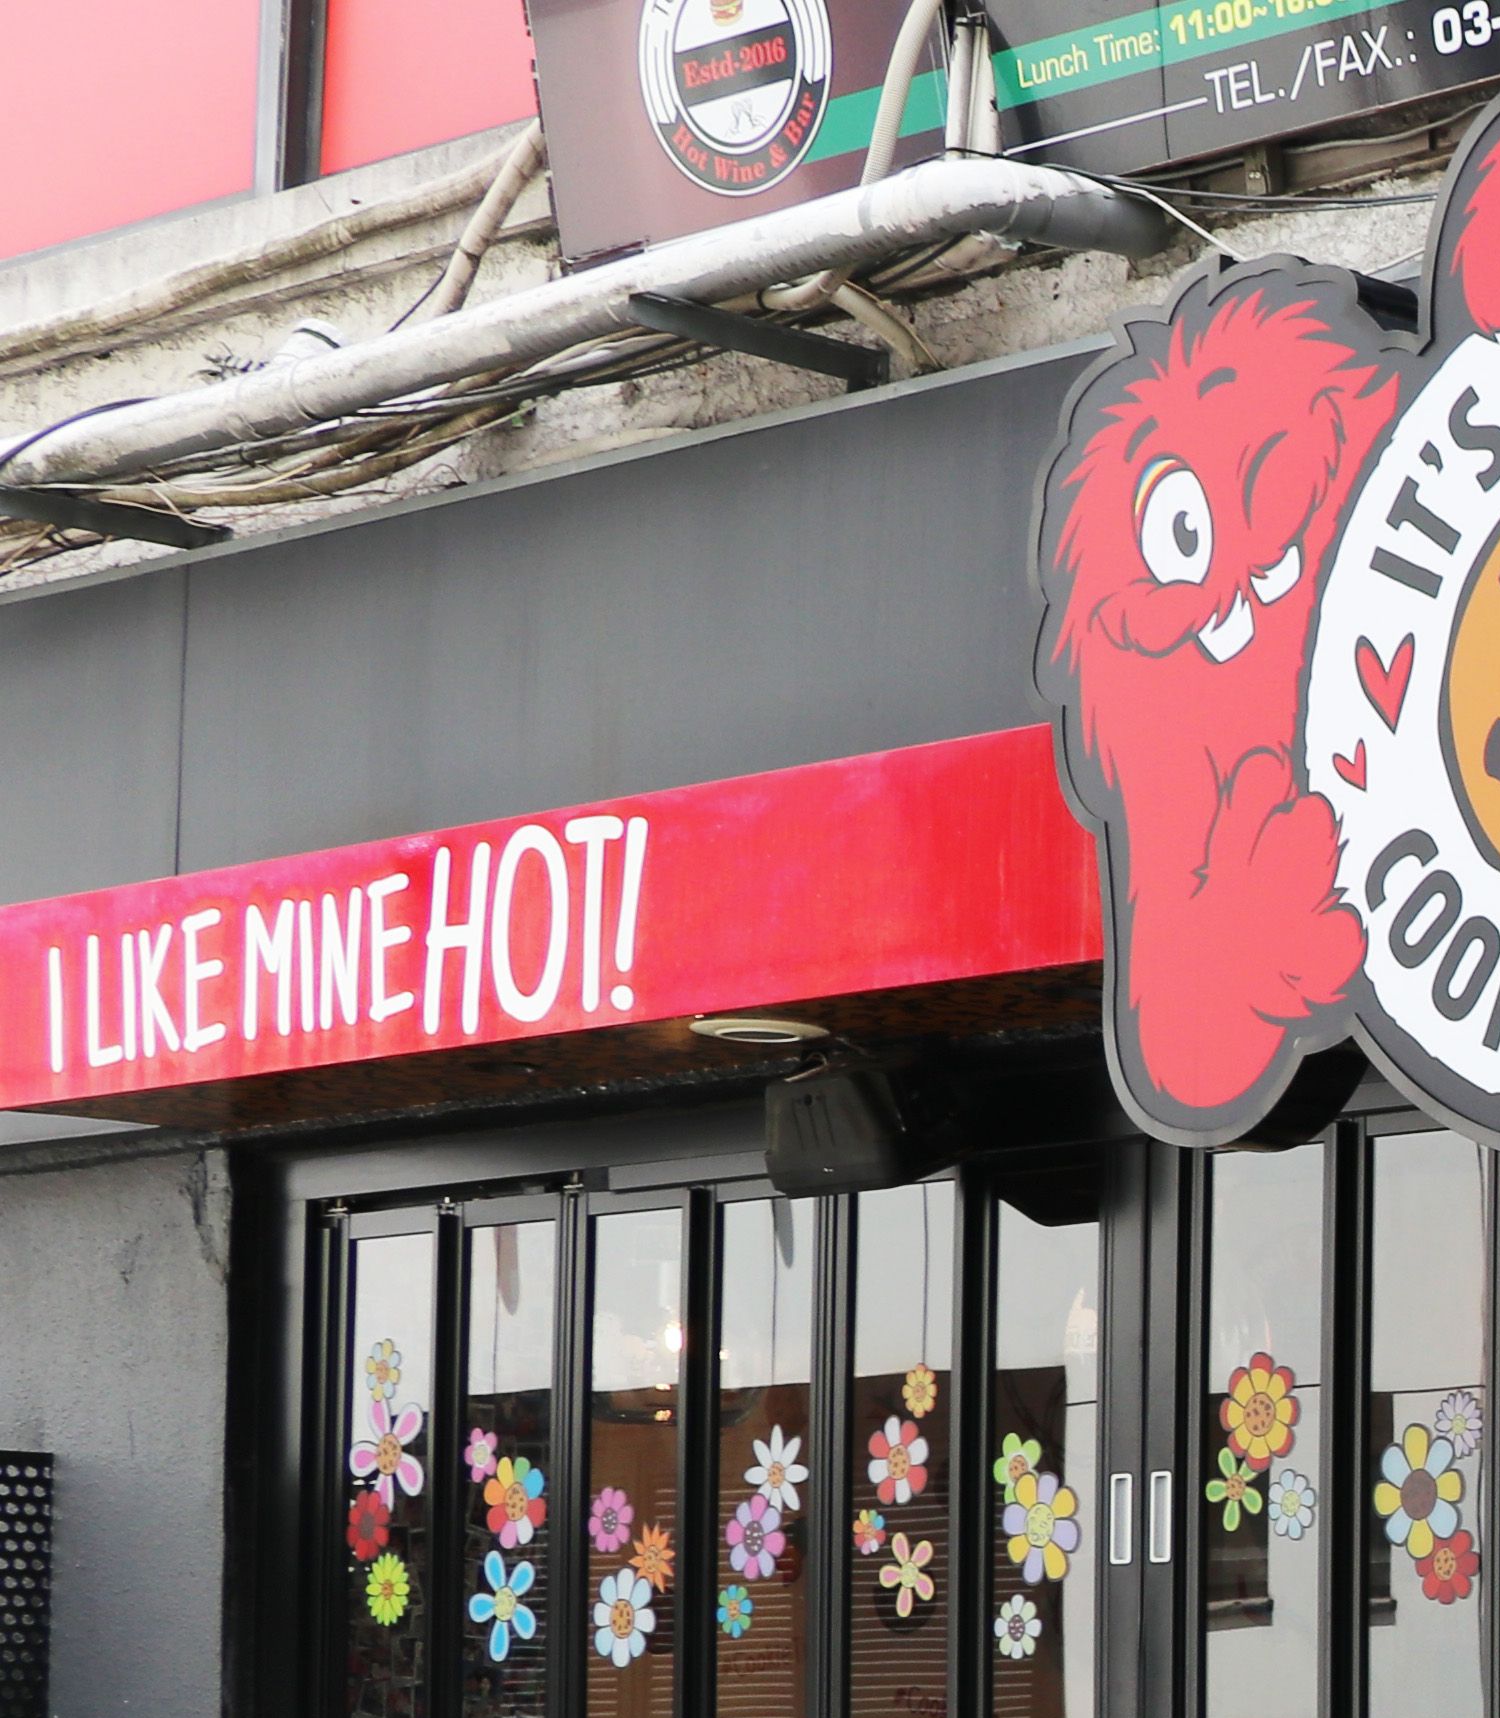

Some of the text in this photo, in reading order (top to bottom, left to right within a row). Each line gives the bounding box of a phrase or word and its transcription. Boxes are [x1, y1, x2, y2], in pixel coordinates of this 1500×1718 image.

[683, 36, 788, 89] Estd-2016
[1017, 26, 1162, 88] Lunch Time:
[671, 91, 816, 183] Hot Wine & Bar
[47, 815, 649, 1073] I LIKE MINE HOT!
